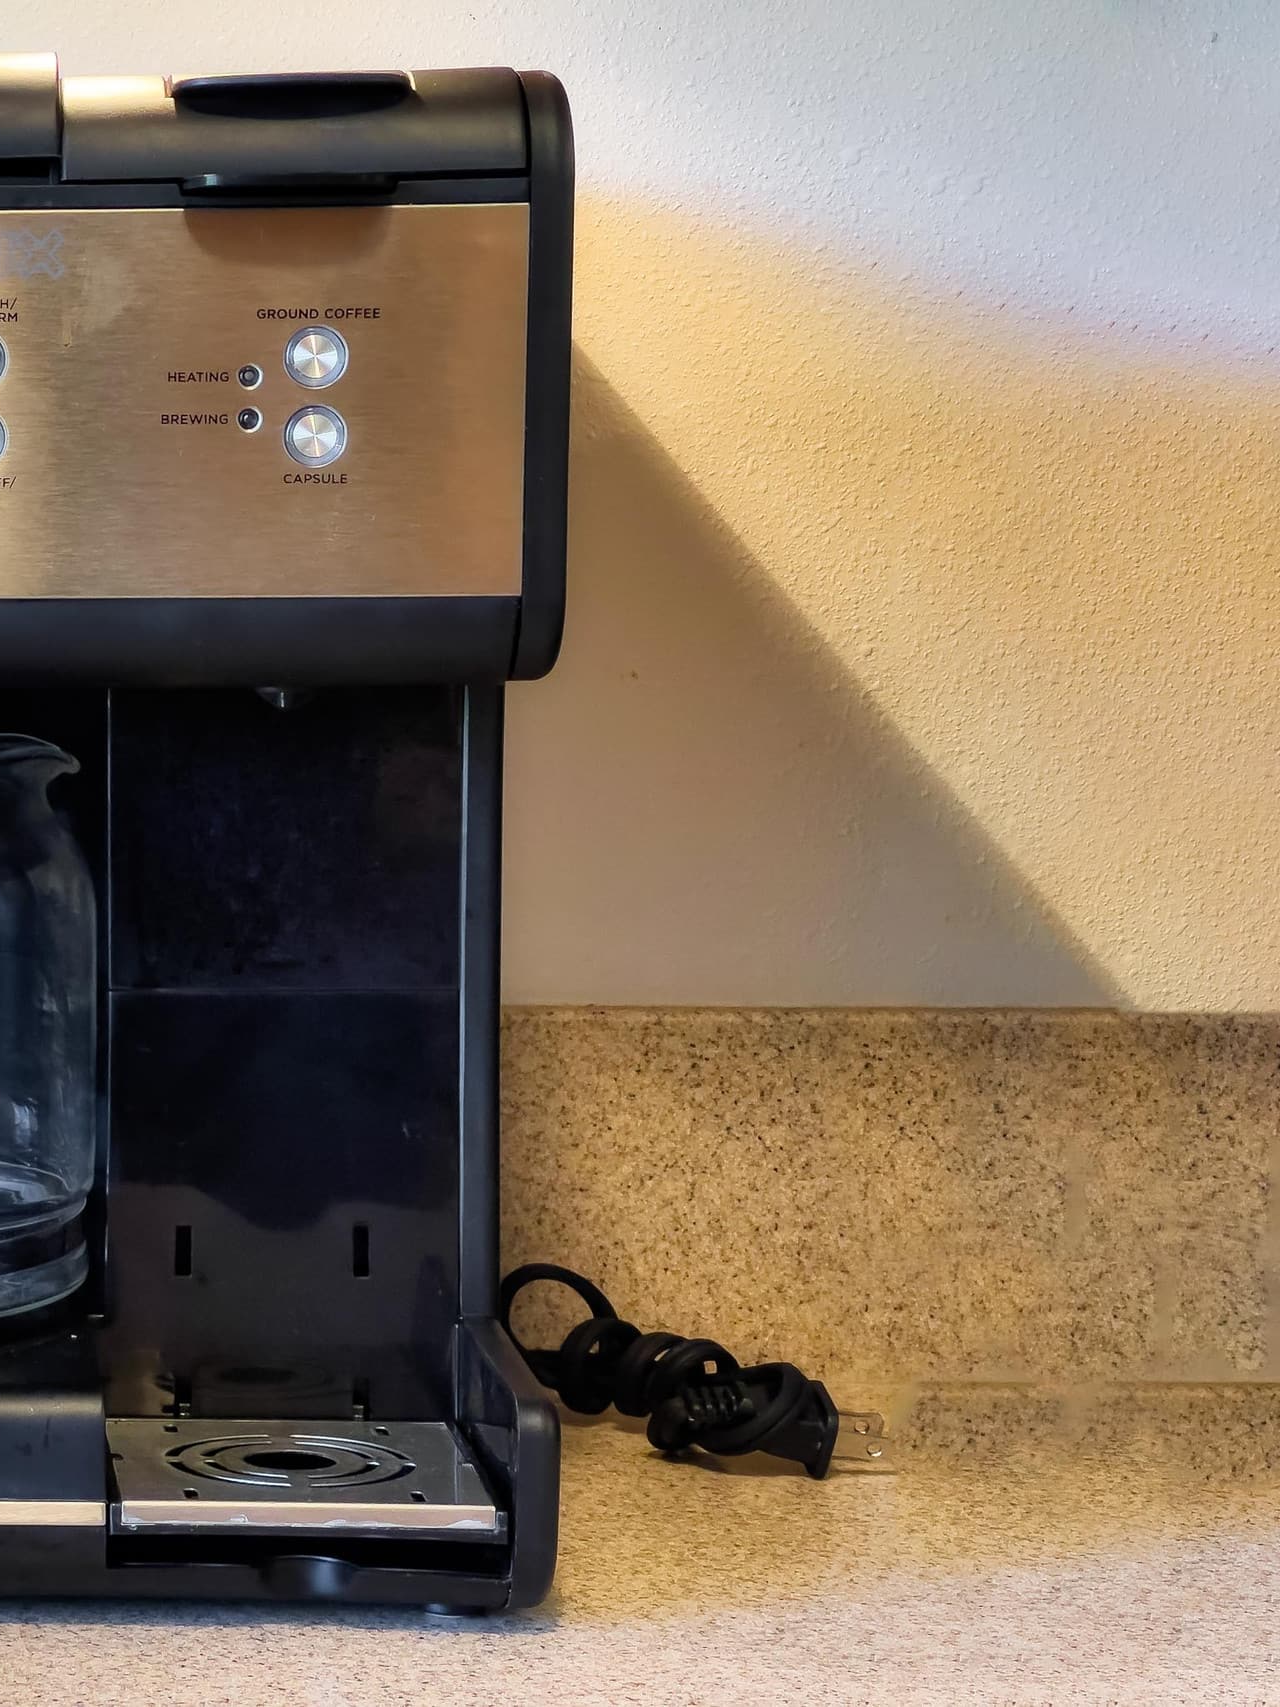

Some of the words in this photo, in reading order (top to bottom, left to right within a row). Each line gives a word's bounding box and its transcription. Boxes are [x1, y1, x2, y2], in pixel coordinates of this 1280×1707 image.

[256, 308, 320, 319] GROUND
[324, 307, 382, 319] COFFEE
[167, 371, 230, 383] HEATING
[160, 414, 229, 425] BREWING
[283, 473, 348, 484] CAPSULE
